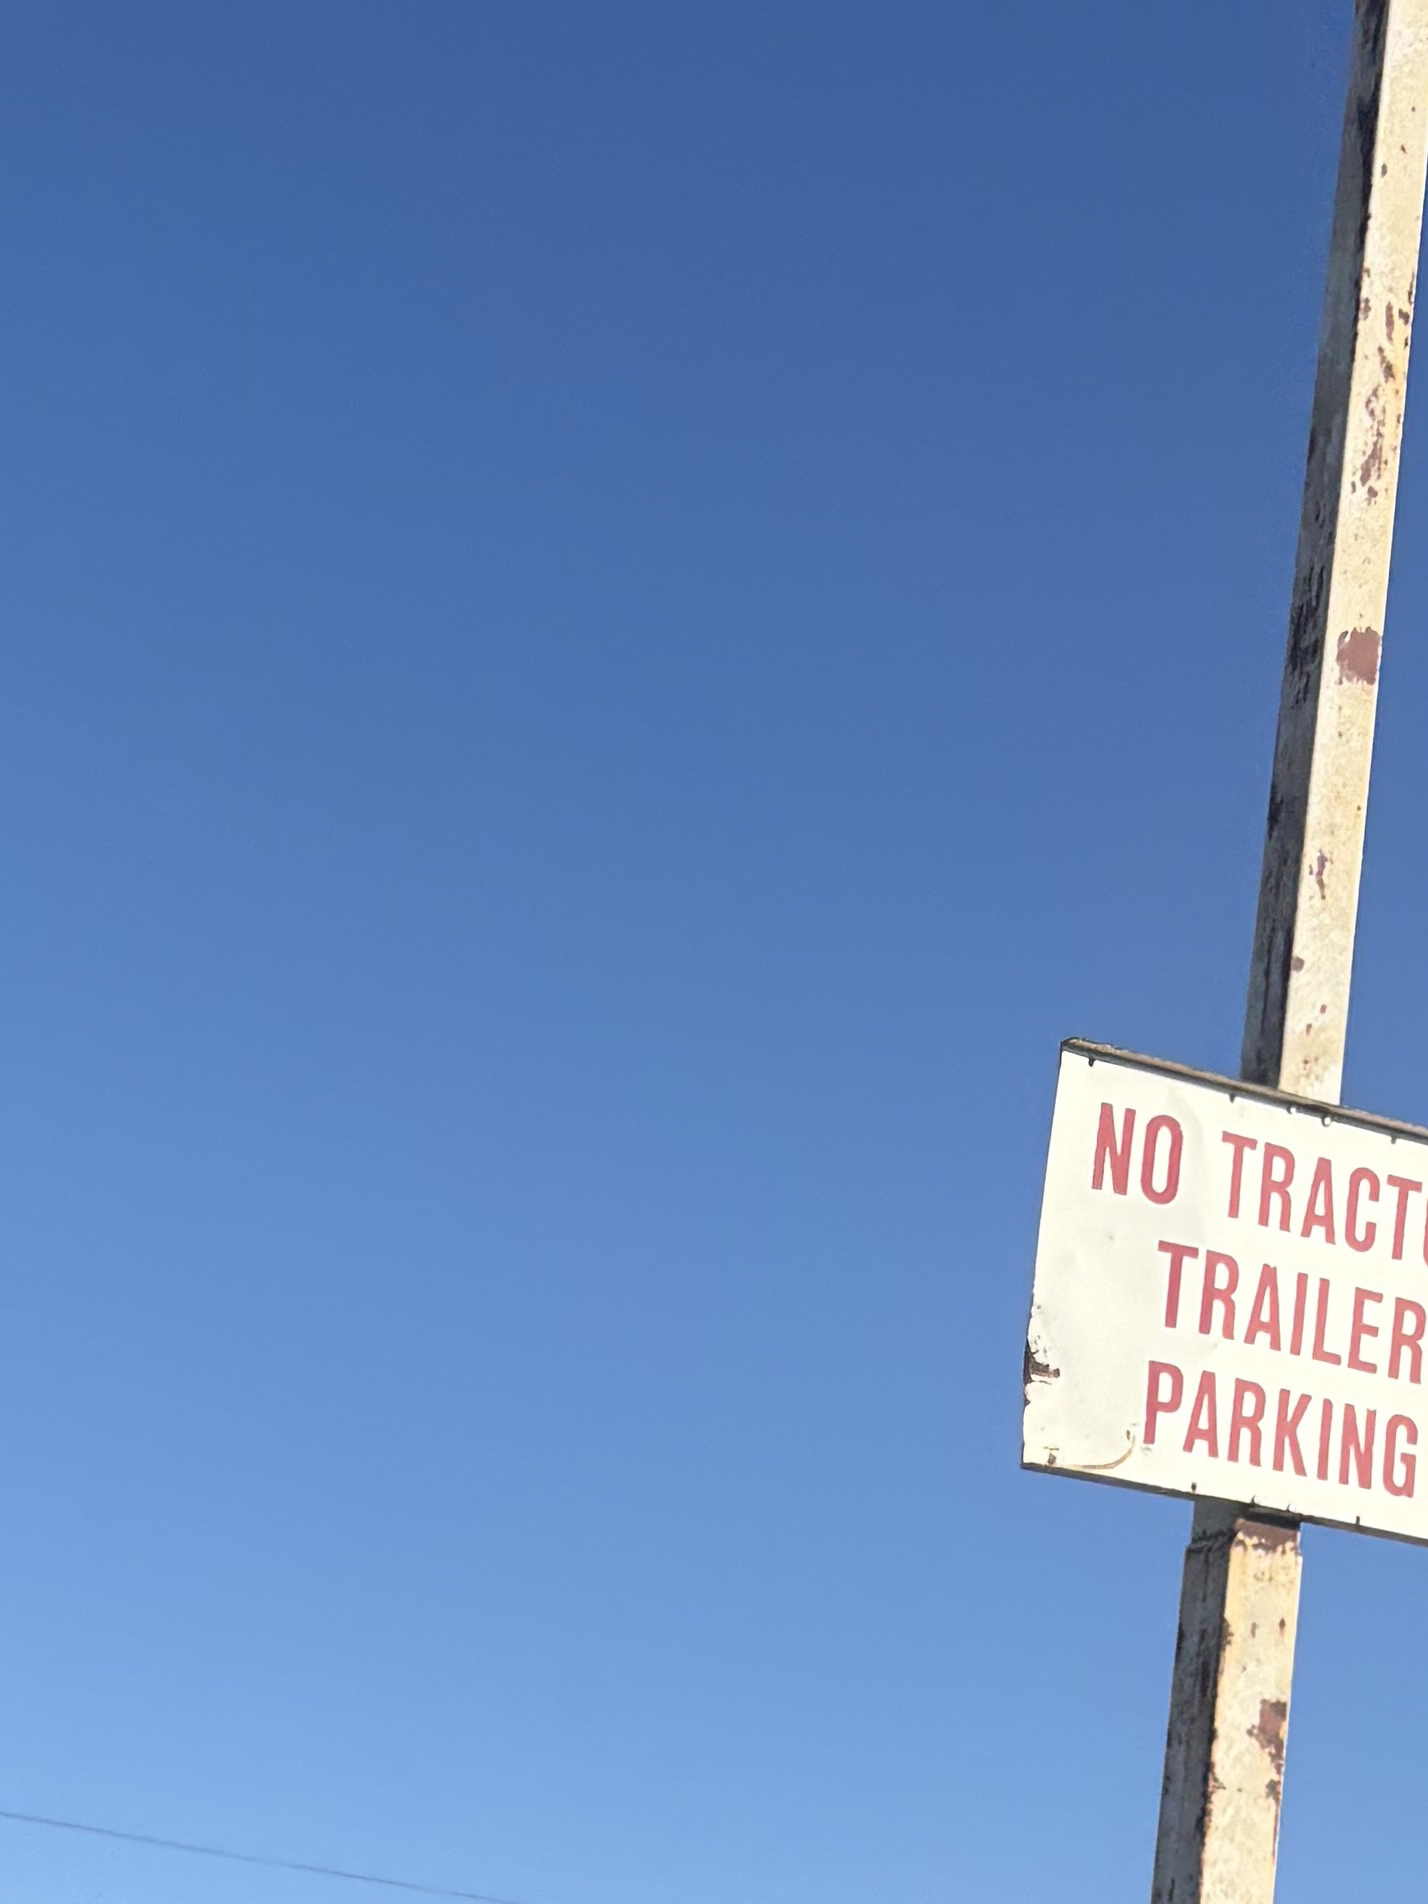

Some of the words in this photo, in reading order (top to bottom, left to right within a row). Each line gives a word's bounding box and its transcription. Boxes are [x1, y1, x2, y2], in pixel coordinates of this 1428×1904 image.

[1091, 1102, 1183, 1205] NO
[1158, 1240, 1427, 1385] TRAILER
[1143, 1361, 1419, 1499] PARKING
